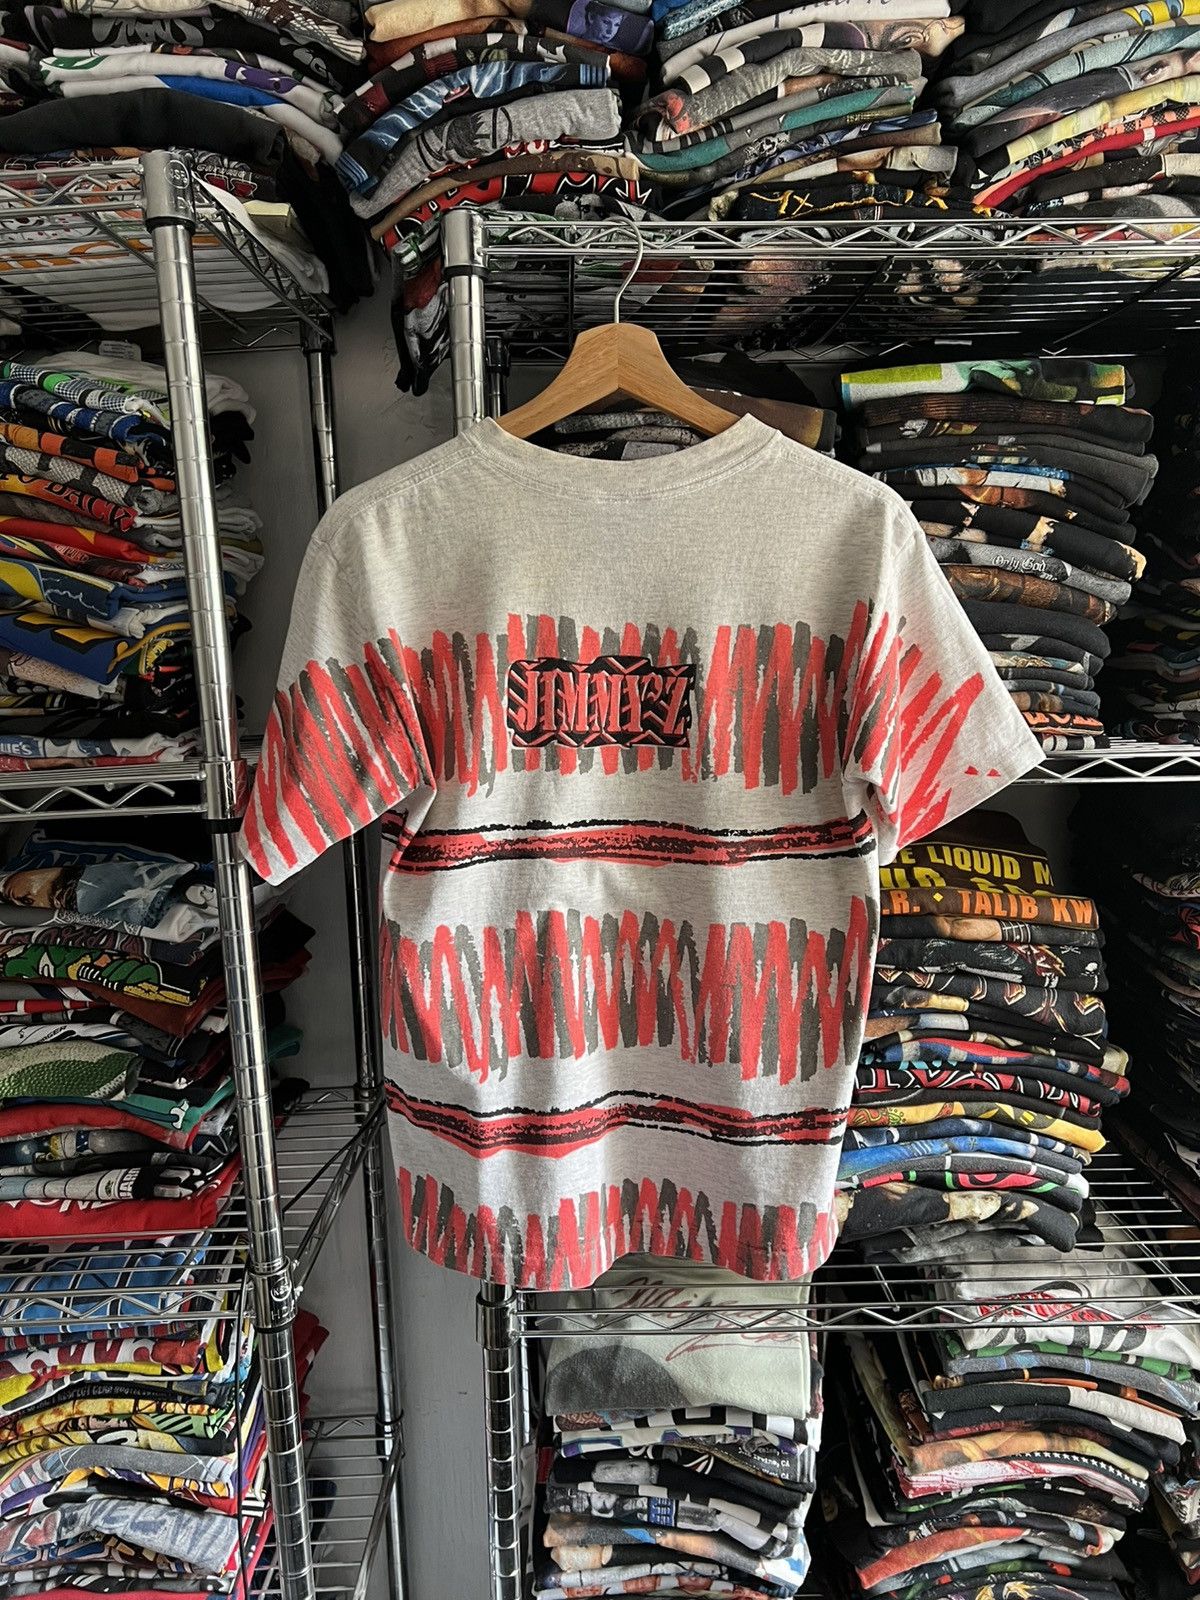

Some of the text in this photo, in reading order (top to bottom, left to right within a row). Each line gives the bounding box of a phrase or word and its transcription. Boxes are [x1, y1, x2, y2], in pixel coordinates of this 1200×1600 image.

[992, 555, 1047, 573] Only God
[926, 845, 1021, 881] LIQUID
[957, 890, 1039, 920] TALIB
[1050, 896, 1093, 924] KW
